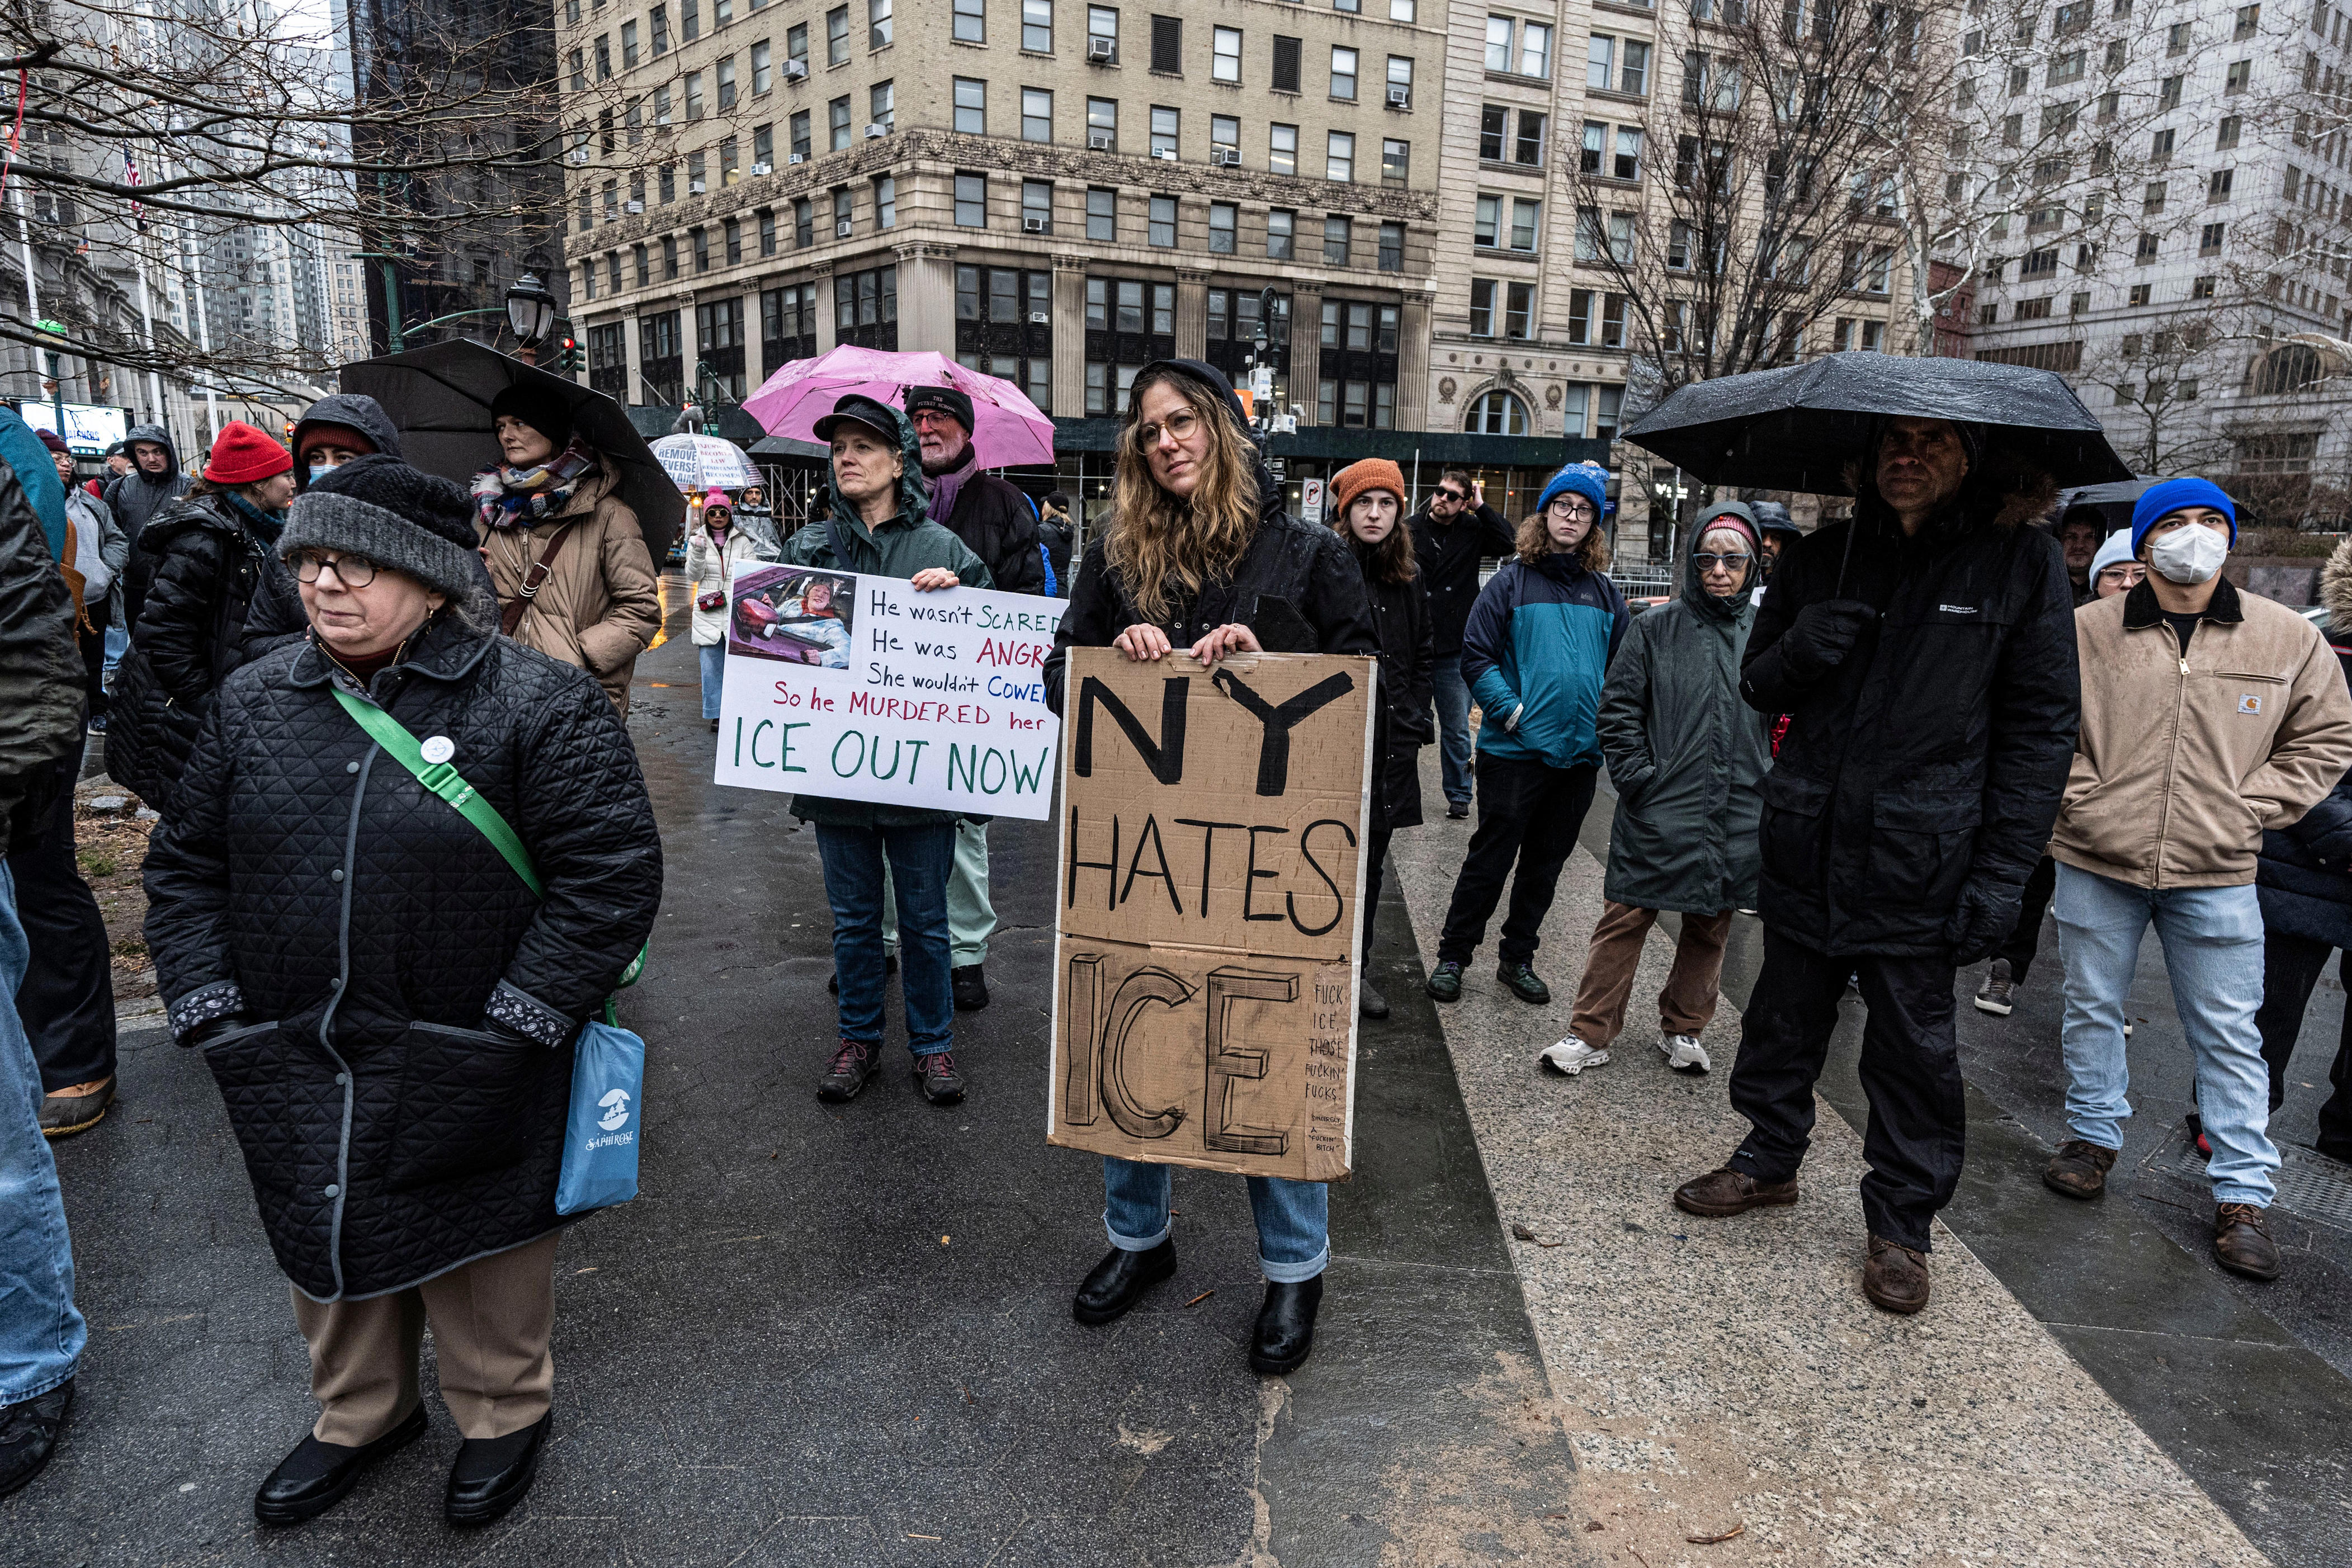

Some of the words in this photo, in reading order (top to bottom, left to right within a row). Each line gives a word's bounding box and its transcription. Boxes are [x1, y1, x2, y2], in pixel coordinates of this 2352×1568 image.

[938, 403, 956, 413] SCHOOL
[658, 448, 697, 461] REMOVE
[871, 589, 900, 616] He
[909, 605, 973, 624] wasn't
[976, 605, 1061, 634] SCARED
[873, 628, 903, 653] He
[914, 641, 957, 660] was
[976, 637, 1054, 668] ANGR
[867, 662, 905, 687] She
[913, 673, 979, 693] wouldn't
[988, 676, 1047, 704] COWE
[773, 681, 801, 707] So
[810, 687, 834, 712] he
[849, 691, 990, 724] MURDERED
[1010, 712, 1046, 730] her
[1074, 667, 1356, 797] NY
[734, 717, 811, 773] ICE
[832, 730, 930, 785] OUT
[948, 743, 1049, 795] NOW
[1068, 805, 1357, 937] HATES
[1315, 984, 1343, 1005] FUCK
[1313, 1013, 1339, 1032] ICE,
[1065, 952, 1301, 1156] ICE
[1309, 1037, 1344, 1059] THOSE
[1305, 1063, 1344, 1080] FUCKIN'
[1305, 1082, 1341, 1100] FUCKS.
[585, 1131, 634, 1150] SAPHIROSE
